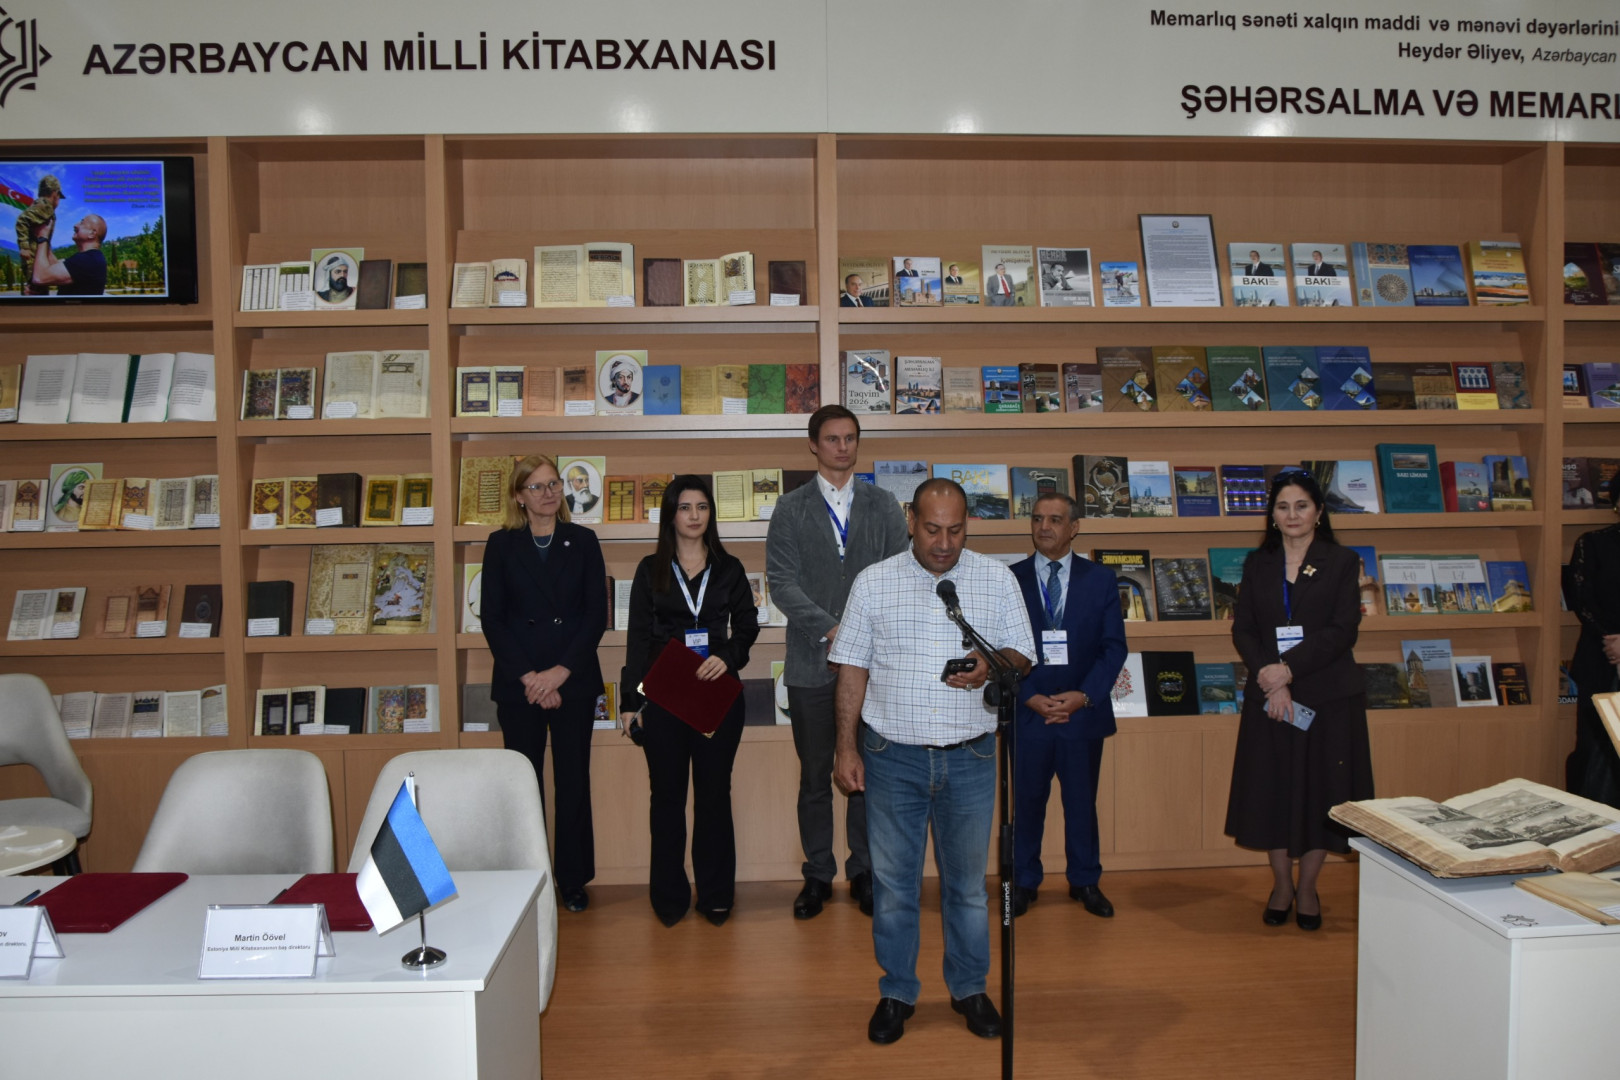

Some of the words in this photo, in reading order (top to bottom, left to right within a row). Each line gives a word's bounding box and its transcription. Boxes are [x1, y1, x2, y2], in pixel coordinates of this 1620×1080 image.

[1150, 10, 1236, 31] Memarlıq
[1242, 12, 1298, 28] sənəti
[1303, 13, 1359, 32] xalqın
[1365, 14, 1420, 31] maddi
[1428, 19, 1450, 32] və
[1457, 18, 1521, 34] mənəvi
[1526, 18, 1620, 38] dəyərlərini
[82, 40, 368, 76] AZƏRBAYCAN
[383, 31, 487, 71] MİLLİ
[503, 31, 776, 71] KİTABXANASI
[1398, 42, 1462, 62] Heydər
[1467, 43, 1525, 64] Əliyev,
[1532, 47, 1617, 66] Azərbaycan
[1180, 84, 1425, 119] ŞƏHƏRSALMA
[1433, 89, 1479, 117] VƏ
[1242, 277, 1269, 286] BAKI
[1305, 277, 1331, 286] BAKI
[848, 390, 880, 400] Təqvim
[951, 469, 990, 485] BAKI
[234, 934, 260, 942] Martin
